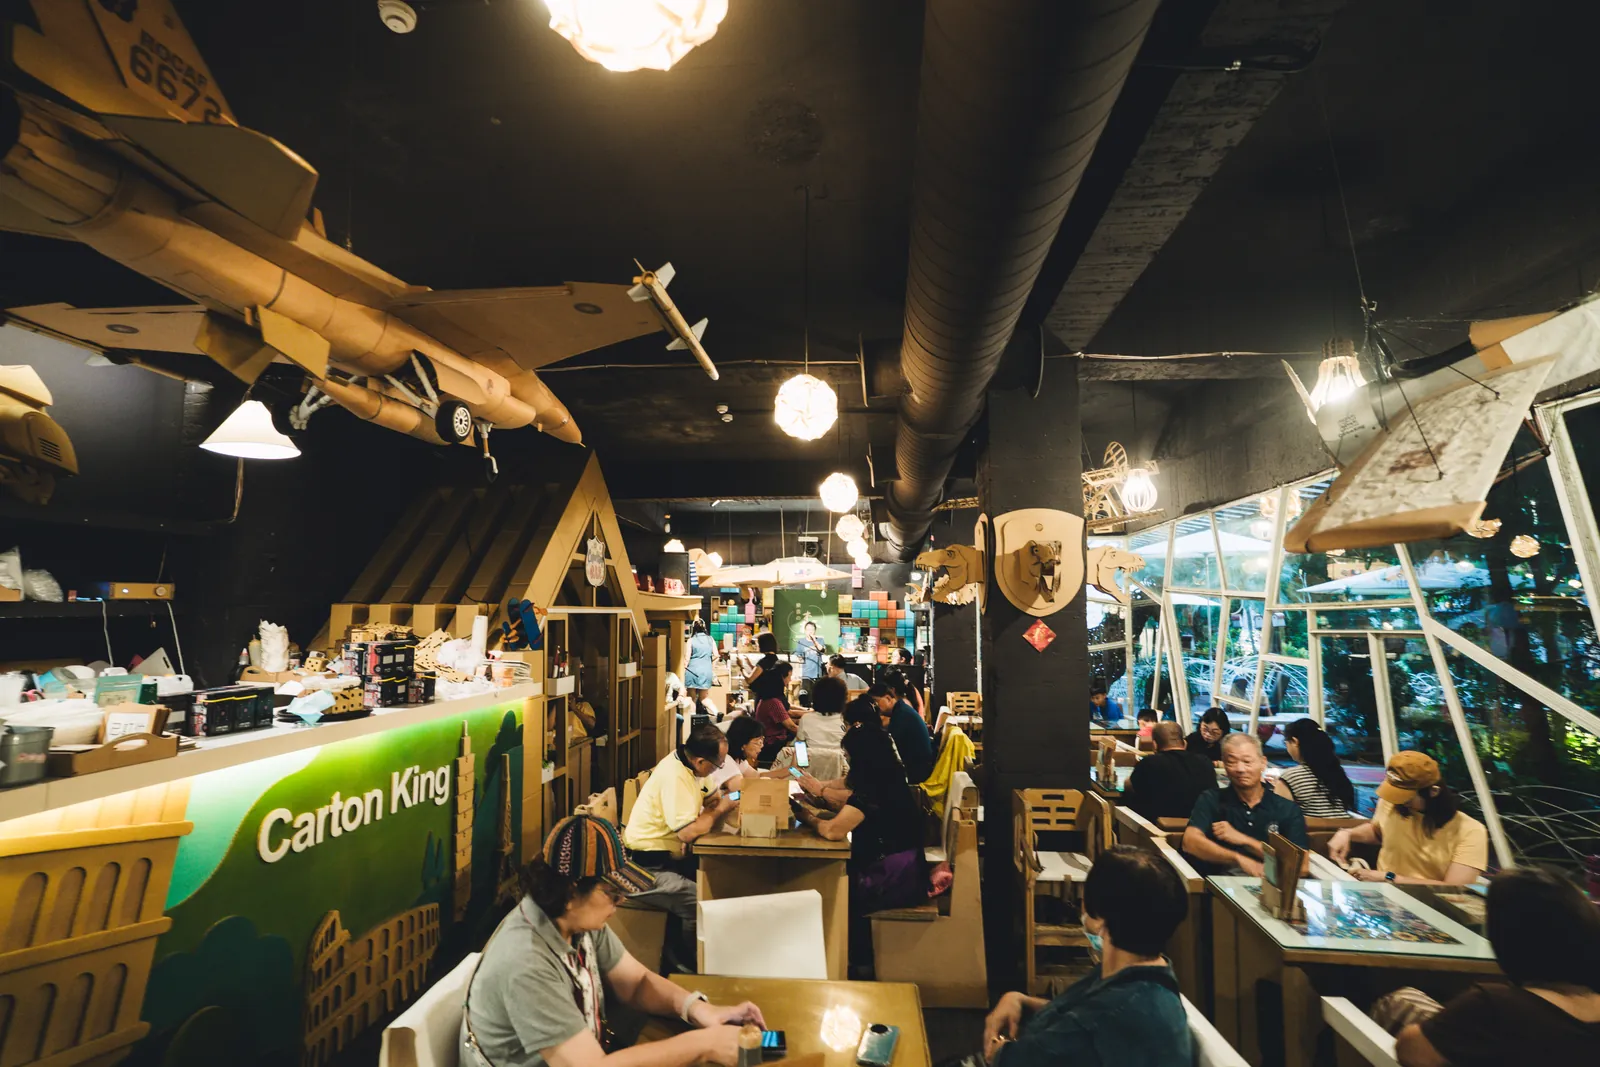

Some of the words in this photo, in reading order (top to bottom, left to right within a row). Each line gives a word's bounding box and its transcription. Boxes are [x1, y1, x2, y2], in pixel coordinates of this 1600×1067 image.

[130, 44, 222, 124] 6672
[140, 29, 208, 87] ROCAF
[257, 788, 383, 863] Carton
[390, 765, 450, 814] King
